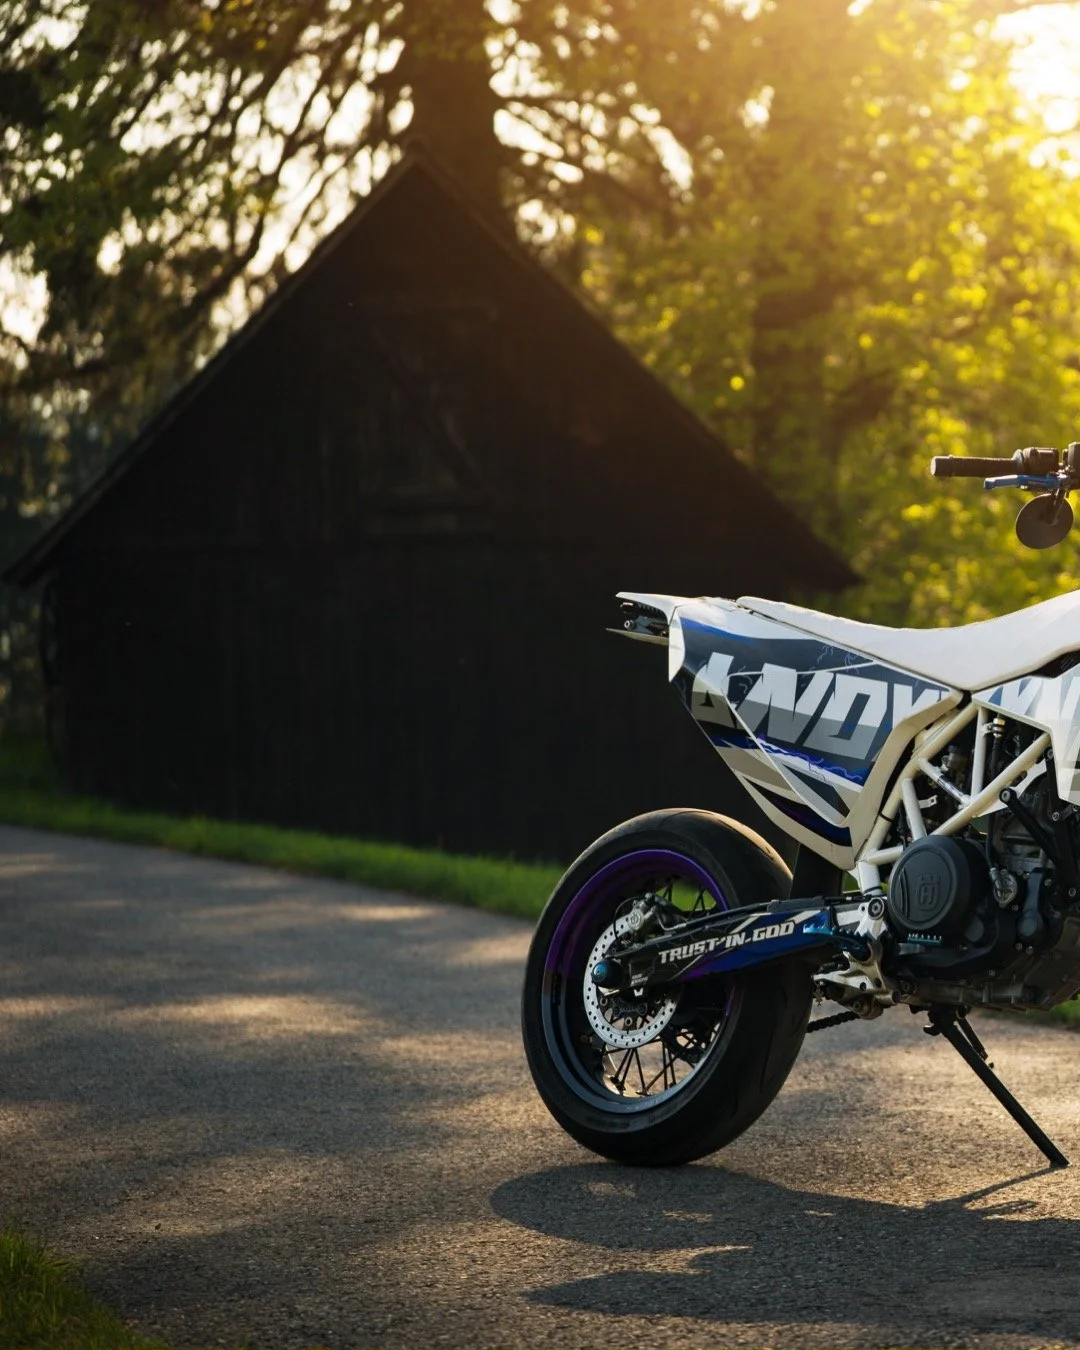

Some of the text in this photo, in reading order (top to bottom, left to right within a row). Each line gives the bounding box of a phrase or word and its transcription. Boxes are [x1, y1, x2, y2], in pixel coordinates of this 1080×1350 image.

[658, 920, 796, 964] TRUST IN GOD
